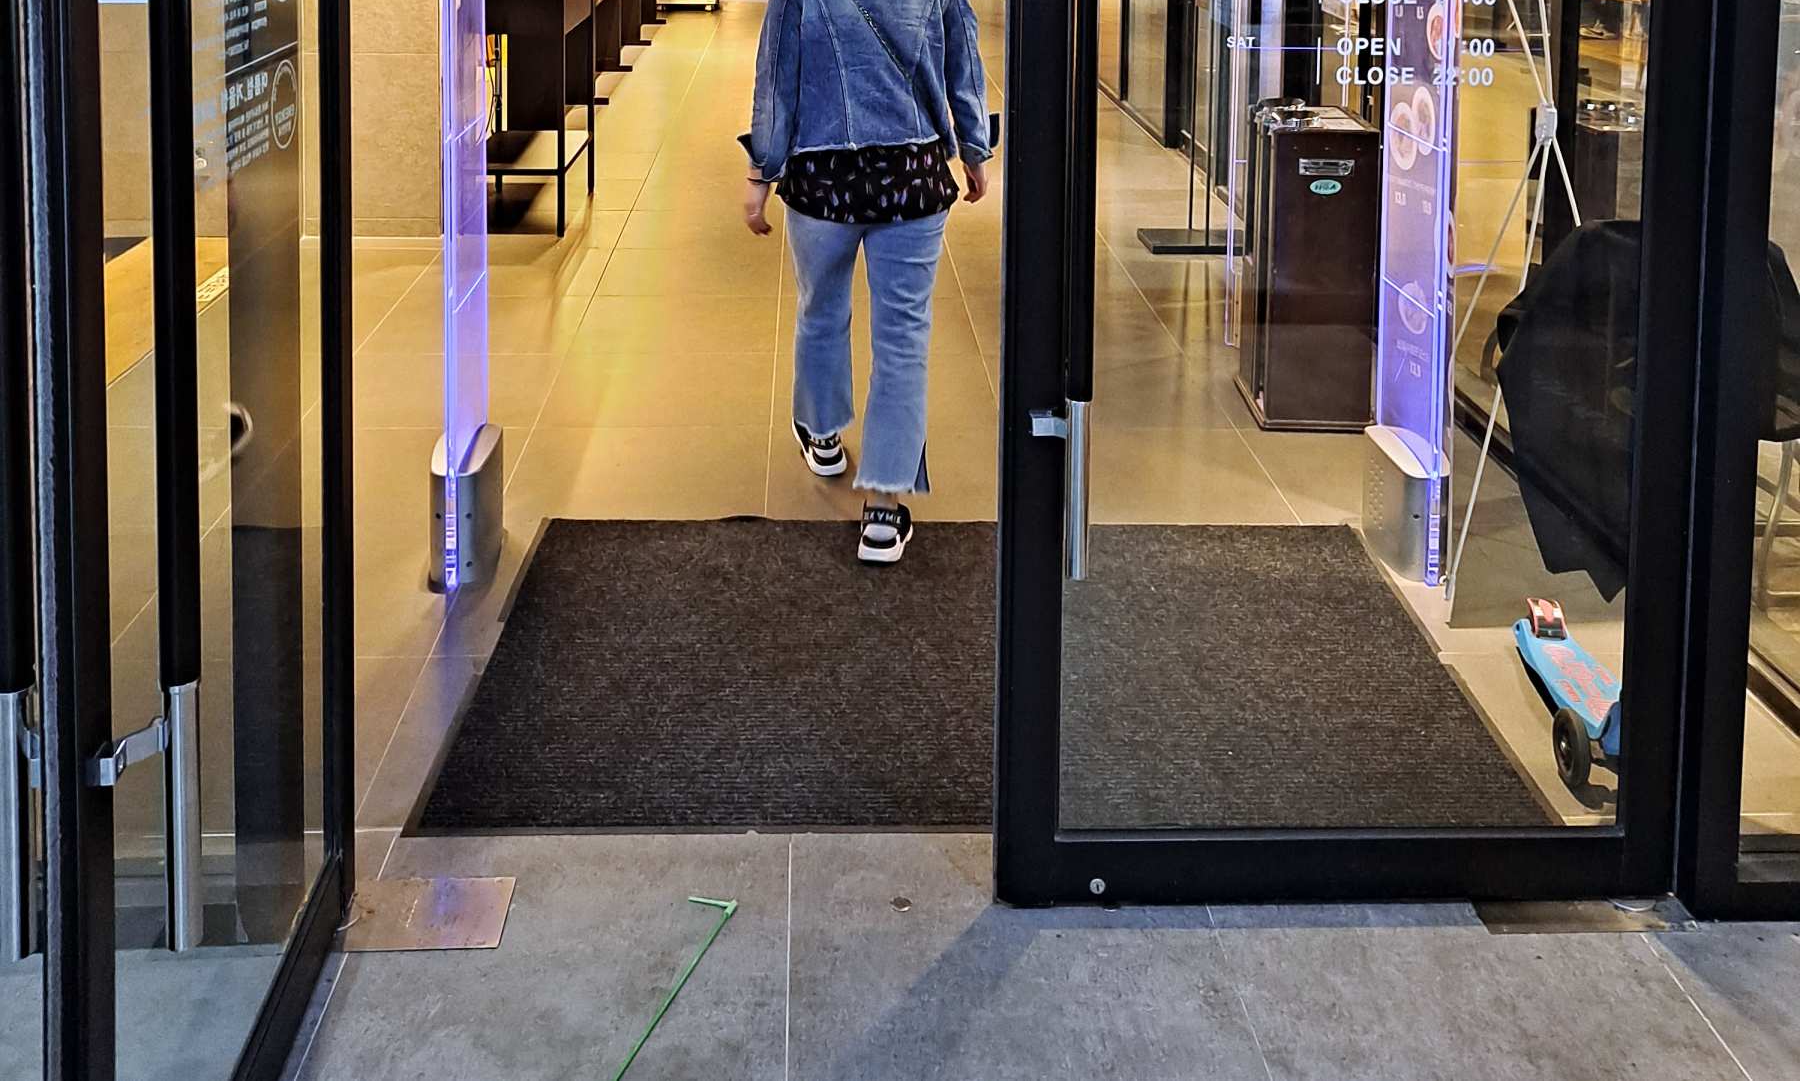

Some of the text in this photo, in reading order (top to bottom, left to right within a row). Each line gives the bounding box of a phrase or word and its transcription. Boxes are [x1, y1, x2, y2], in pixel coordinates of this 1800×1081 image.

[1226, 36, 1257, 49] SAT
[1336, 37, 1401, 56] OPEN
[1335, 66, 1415, 86] CLOSE
